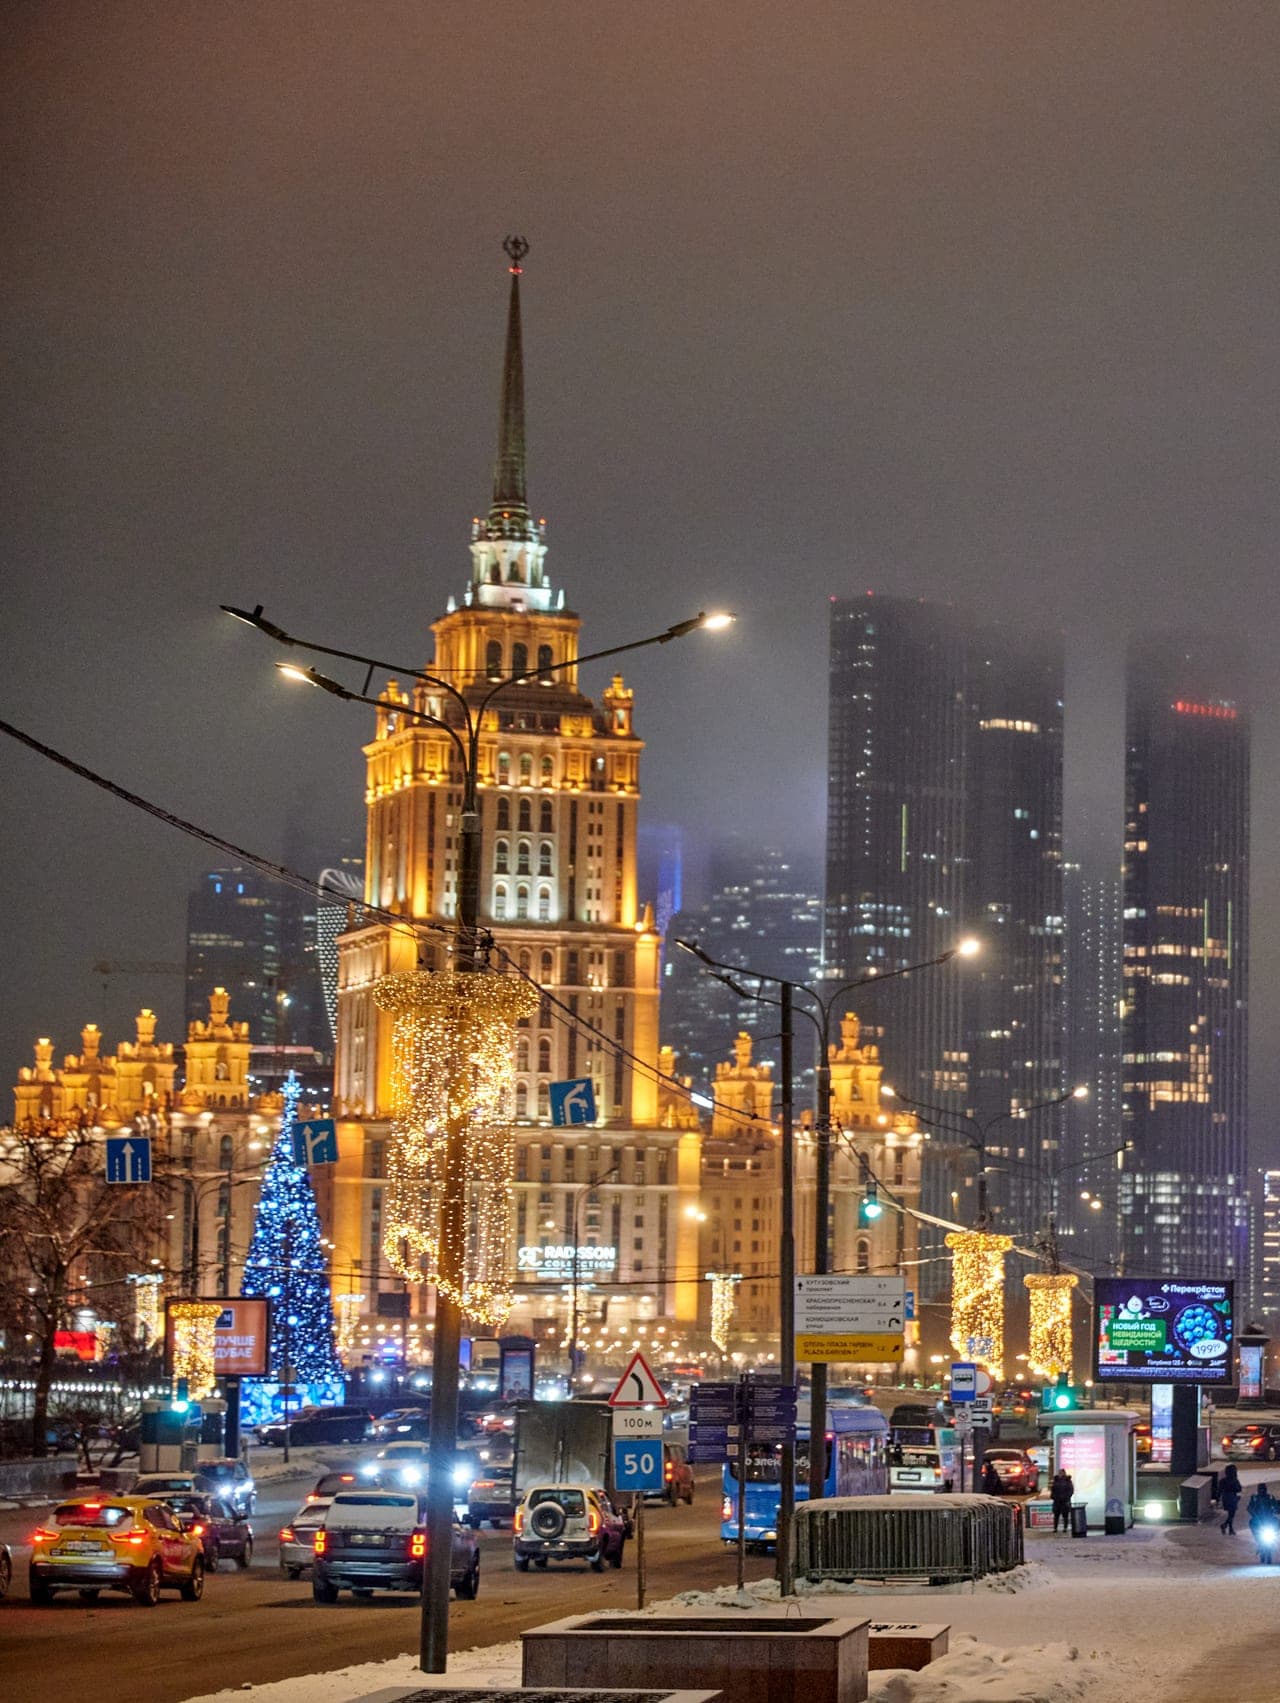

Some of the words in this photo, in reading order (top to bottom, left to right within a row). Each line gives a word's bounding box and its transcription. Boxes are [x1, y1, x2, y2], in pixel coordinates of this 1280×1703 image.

[544, 1246, 616, 1259] RADSSON
[1112, 1322, 1139, 1330] НОВЫЙ
[1141, 1323, 1156, 1331] ГОД
[624, 1453, 654, 1475] 50
